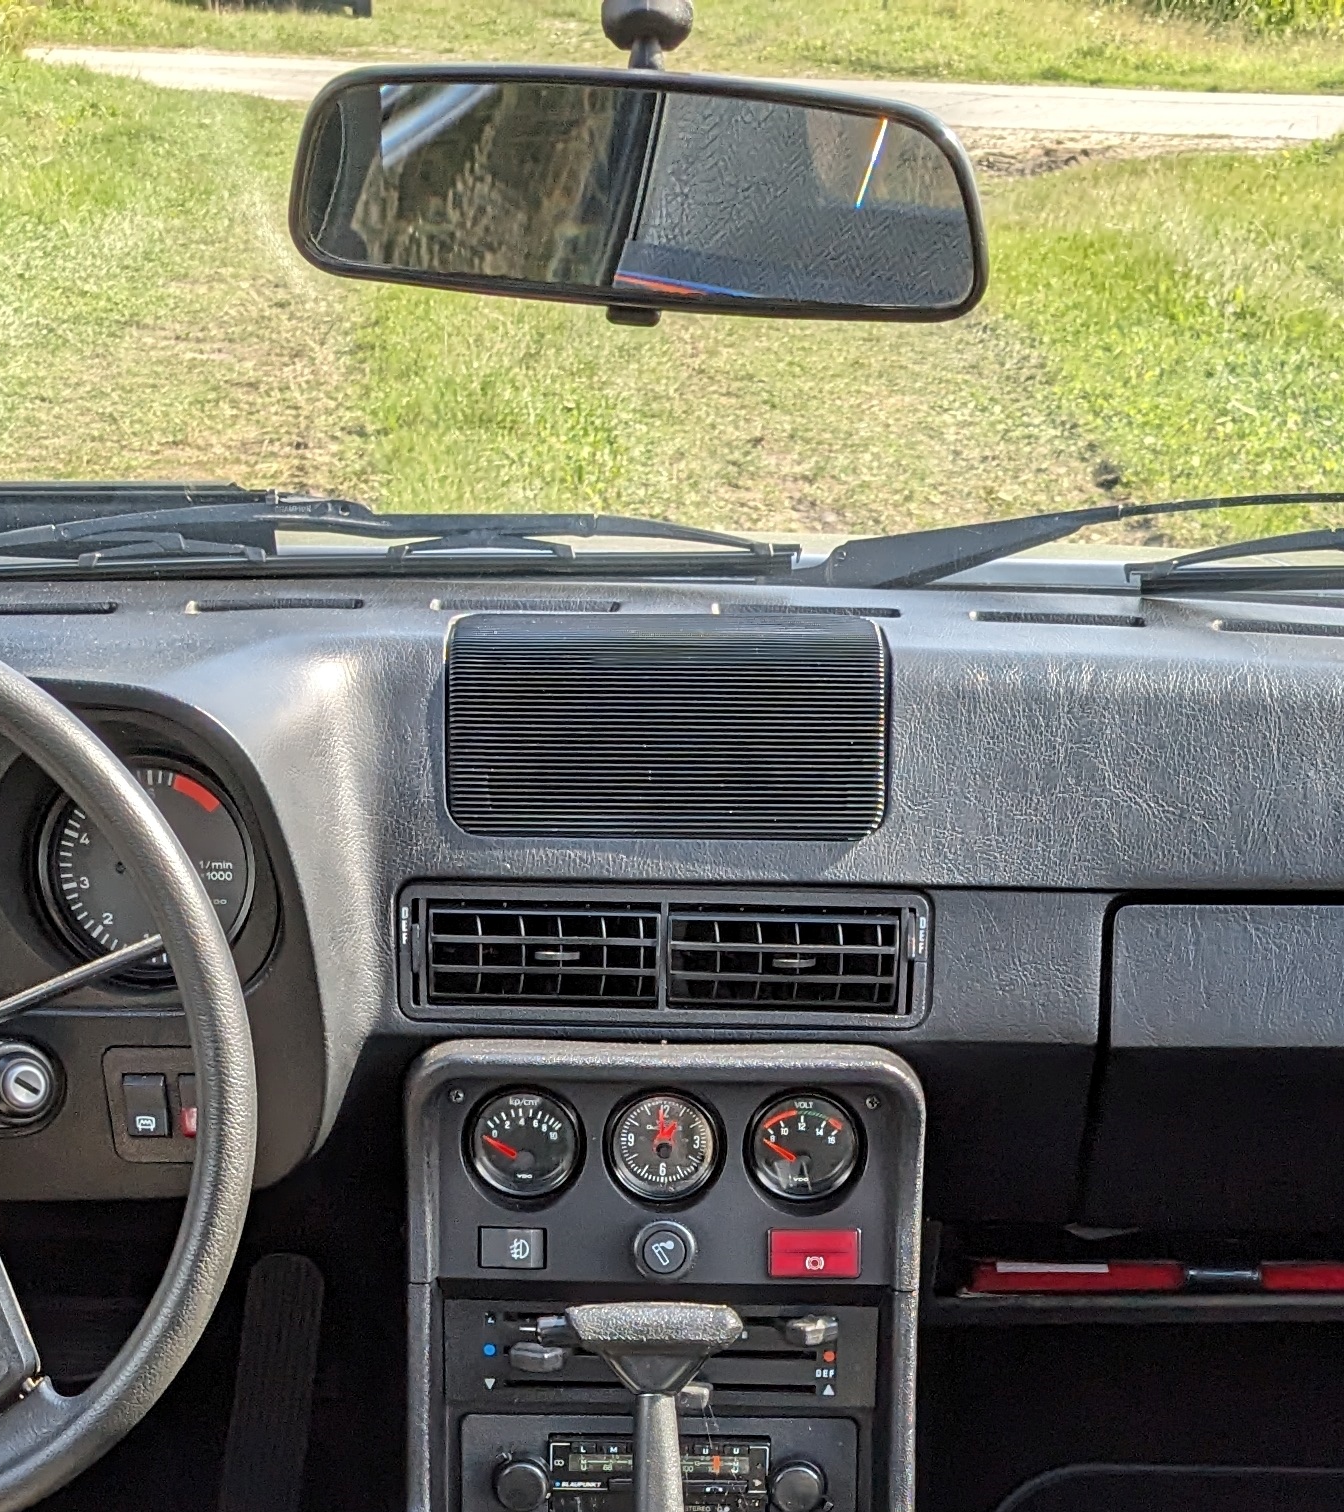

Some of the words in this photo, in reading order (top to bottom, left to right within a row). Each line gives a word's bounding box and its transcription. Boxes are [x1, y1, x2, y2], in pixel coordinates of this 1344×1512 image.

[79, 833, 90, 845] 4
[79, 876, 90, 889] 3
[102, 912, 114, 925] 2
[794, 1101, 814, 1109] VOLT
[504, 1120, 511, 1129] 2
[518, 1118, 525, 1126] 4
[532, 1119, 539, 1128] 6
[797, 1122, 806, 1131] 12
[780, 1127, 789, 1135] 10
[627, 1133, 635, 1146] 9
[693, 1135, 700, 1148] 3
[659, 1162, 667, 1176] 6
[815, 1369, 835, 1378] DEF
